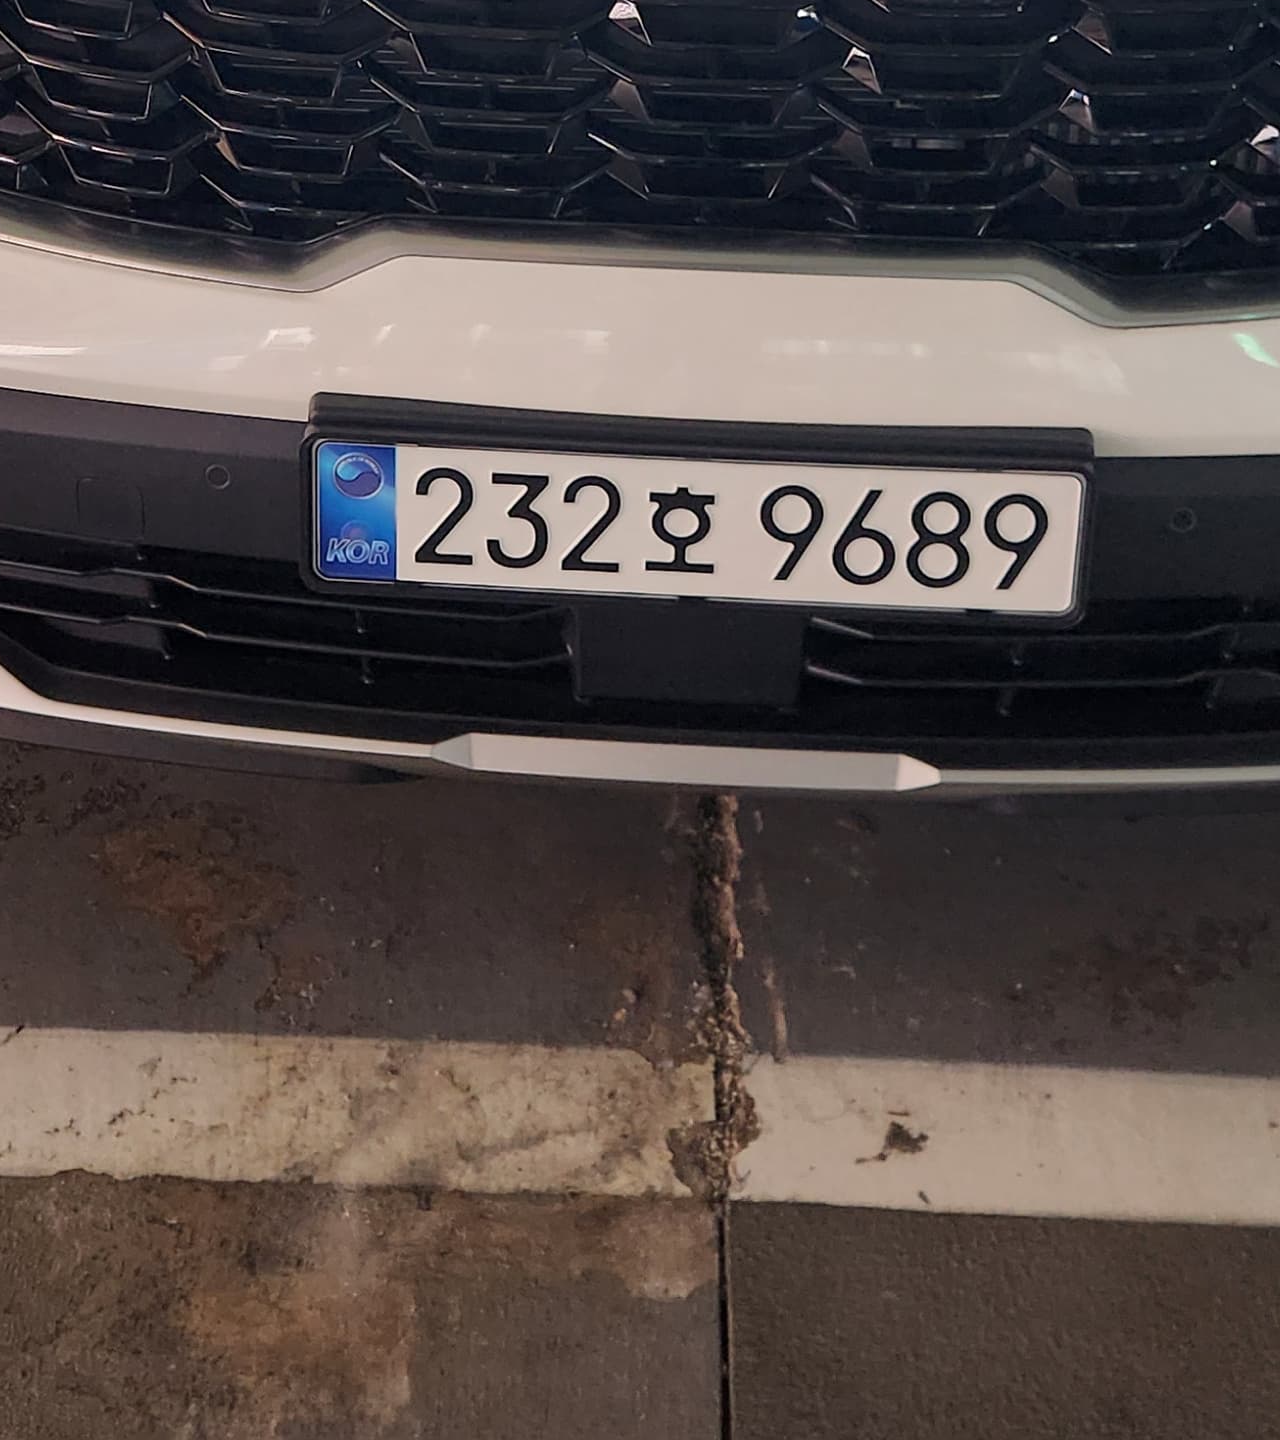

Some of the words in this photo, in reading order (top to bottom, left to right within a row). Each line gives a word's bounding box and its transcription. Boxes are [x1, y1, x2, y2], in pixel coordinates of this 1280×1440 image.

[326, 537, 389, 565] KOR
[415, 468, 715, 573] 232호
[761, 485, 1048, 589] 9689
